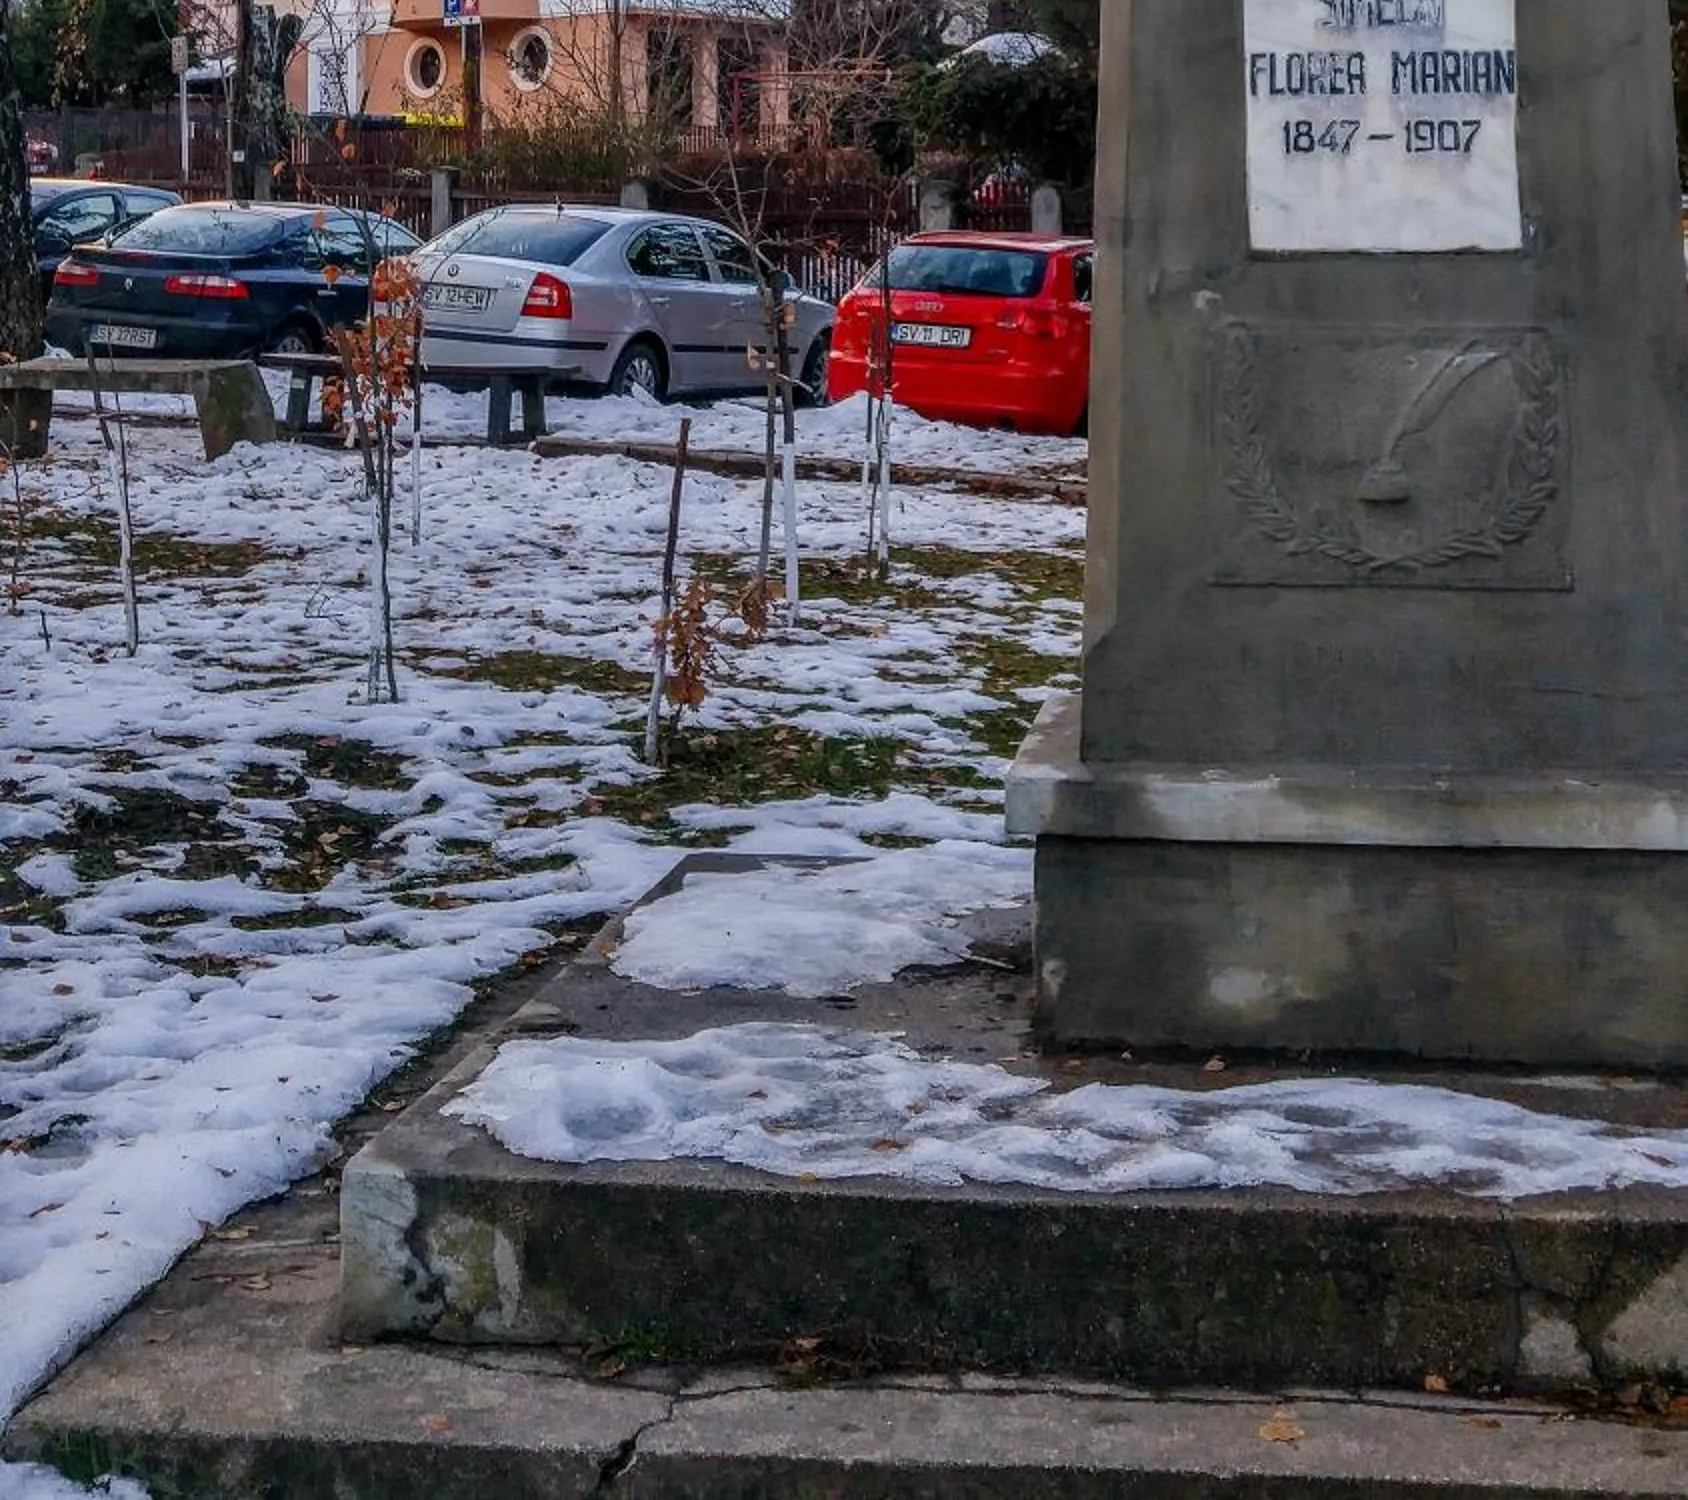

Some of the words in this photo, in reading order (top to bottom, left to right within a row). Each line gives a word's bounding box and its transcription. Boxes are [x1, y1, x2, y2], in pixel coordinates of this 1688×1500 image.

[1250, 50, 1366, 97] FLOREA
[1391, 50, 1515, 96] MARIAN
[899, 325, 918, 340] SV
